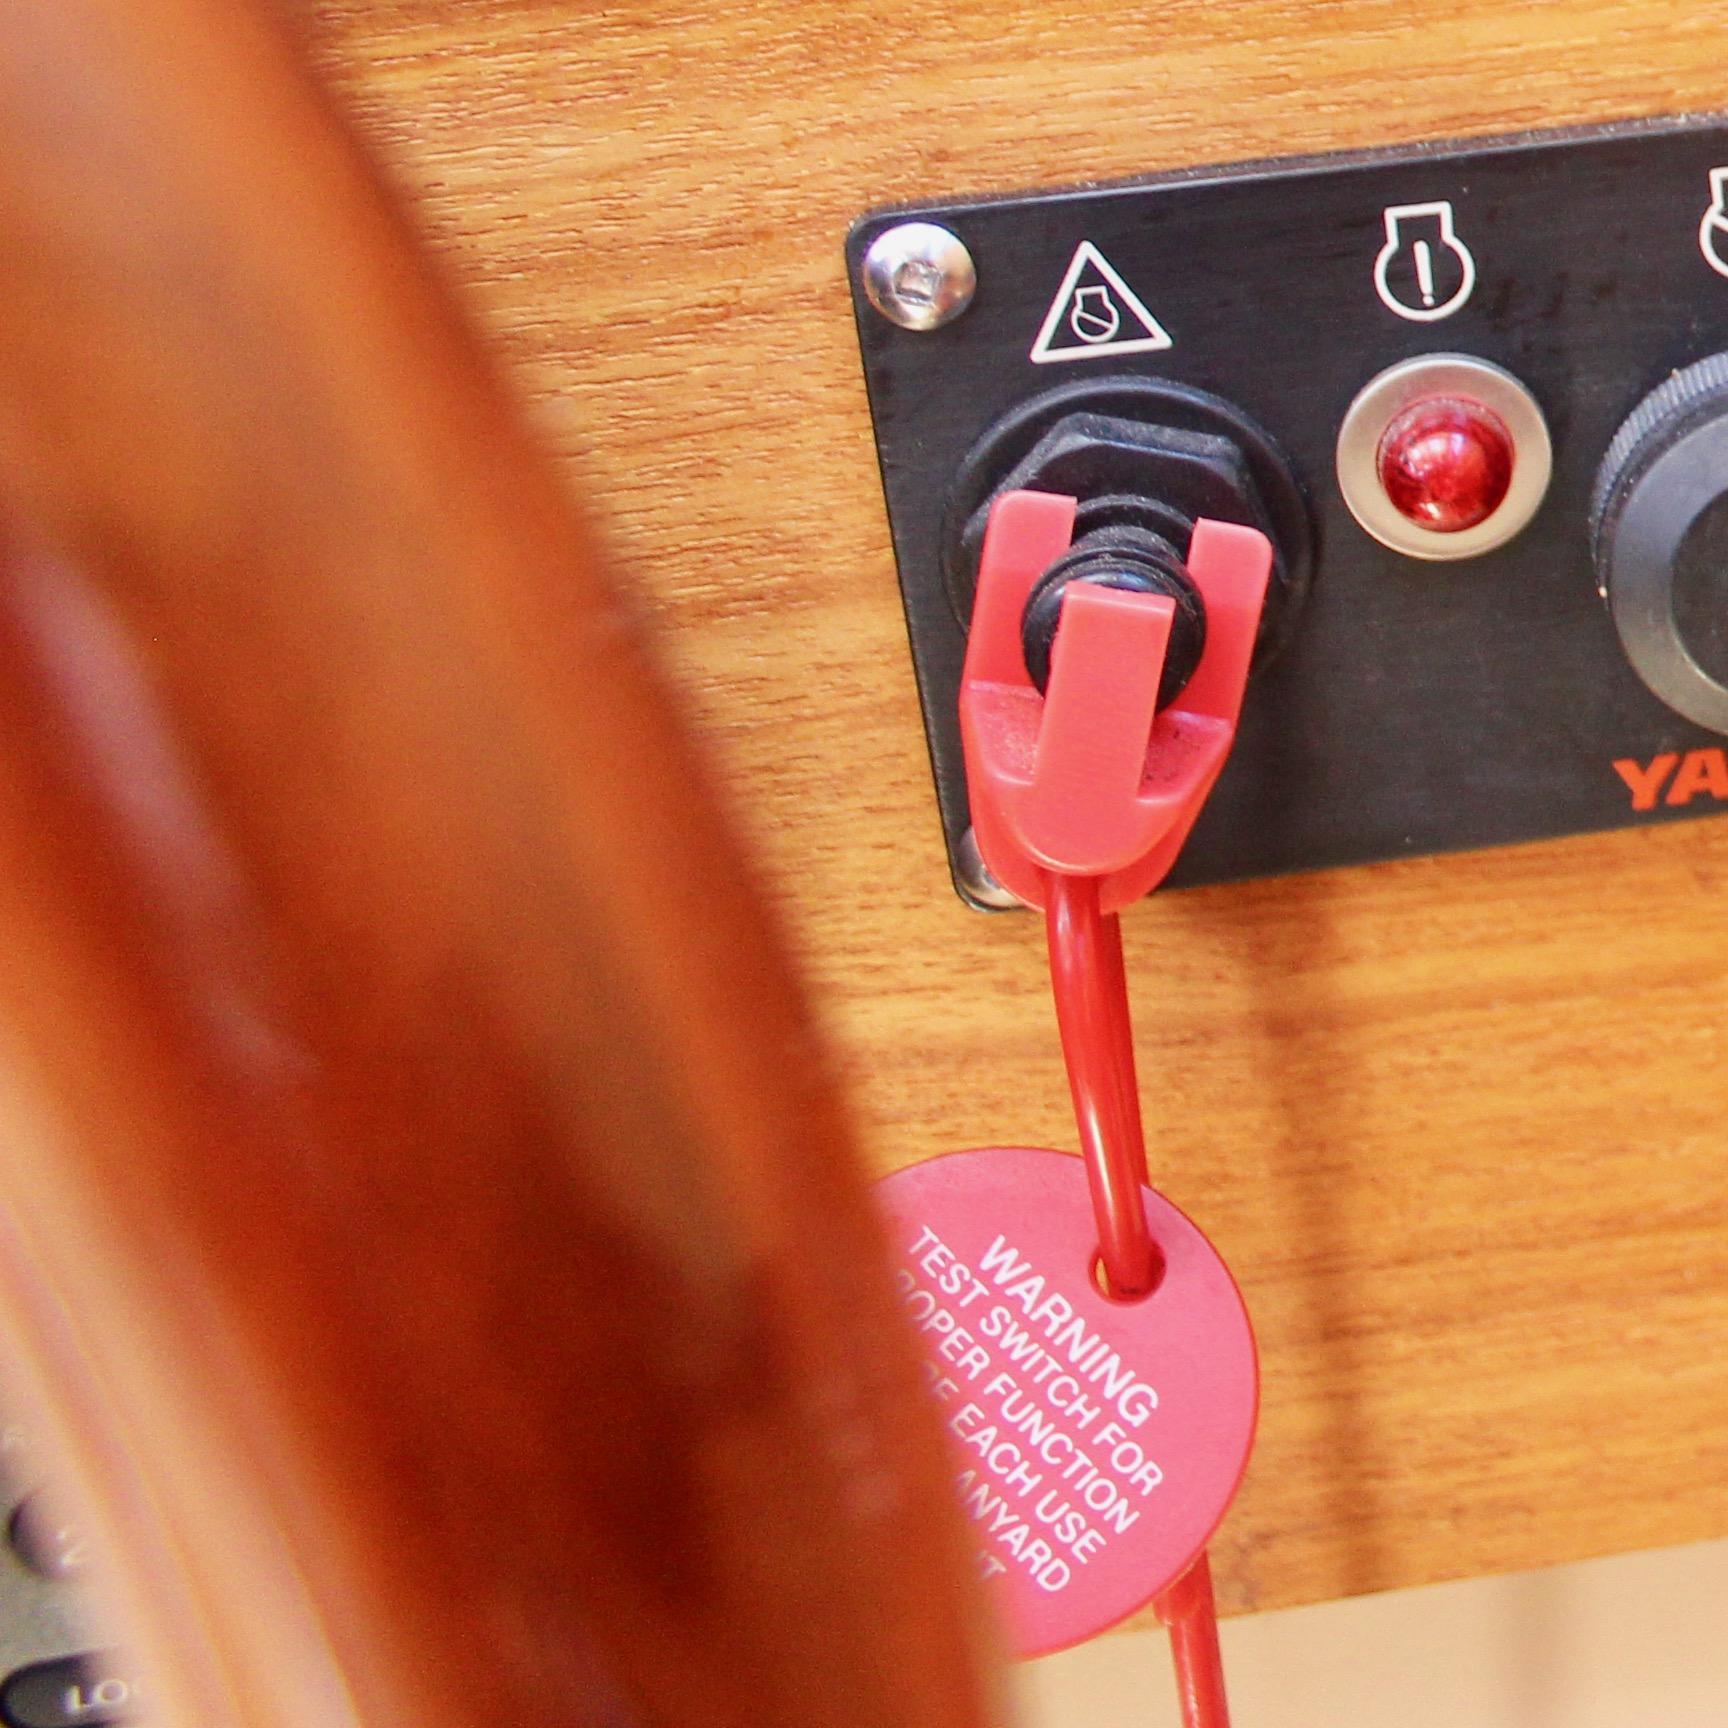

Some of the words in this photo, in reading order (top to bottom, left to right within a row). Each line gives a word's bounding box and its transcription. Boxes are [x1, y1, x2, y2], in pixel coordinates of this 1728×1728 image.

[898, 1270, 991, 1381] OPER
[983, 1371, 1141, 1536] FUNCTION
[907, 1224, 991, 1309] TEST
[978, 1304, 1101, 1431] SWITCH
[1091, 1422, 1165, 1498] FOR
[978, 1233, 1160, 1429] WARNING
[949, 1401, 1043, 1498] EACH
[1035, 1488, 1108, 1565] USE
[956, 1469, 1073, 1594] ANYARD
